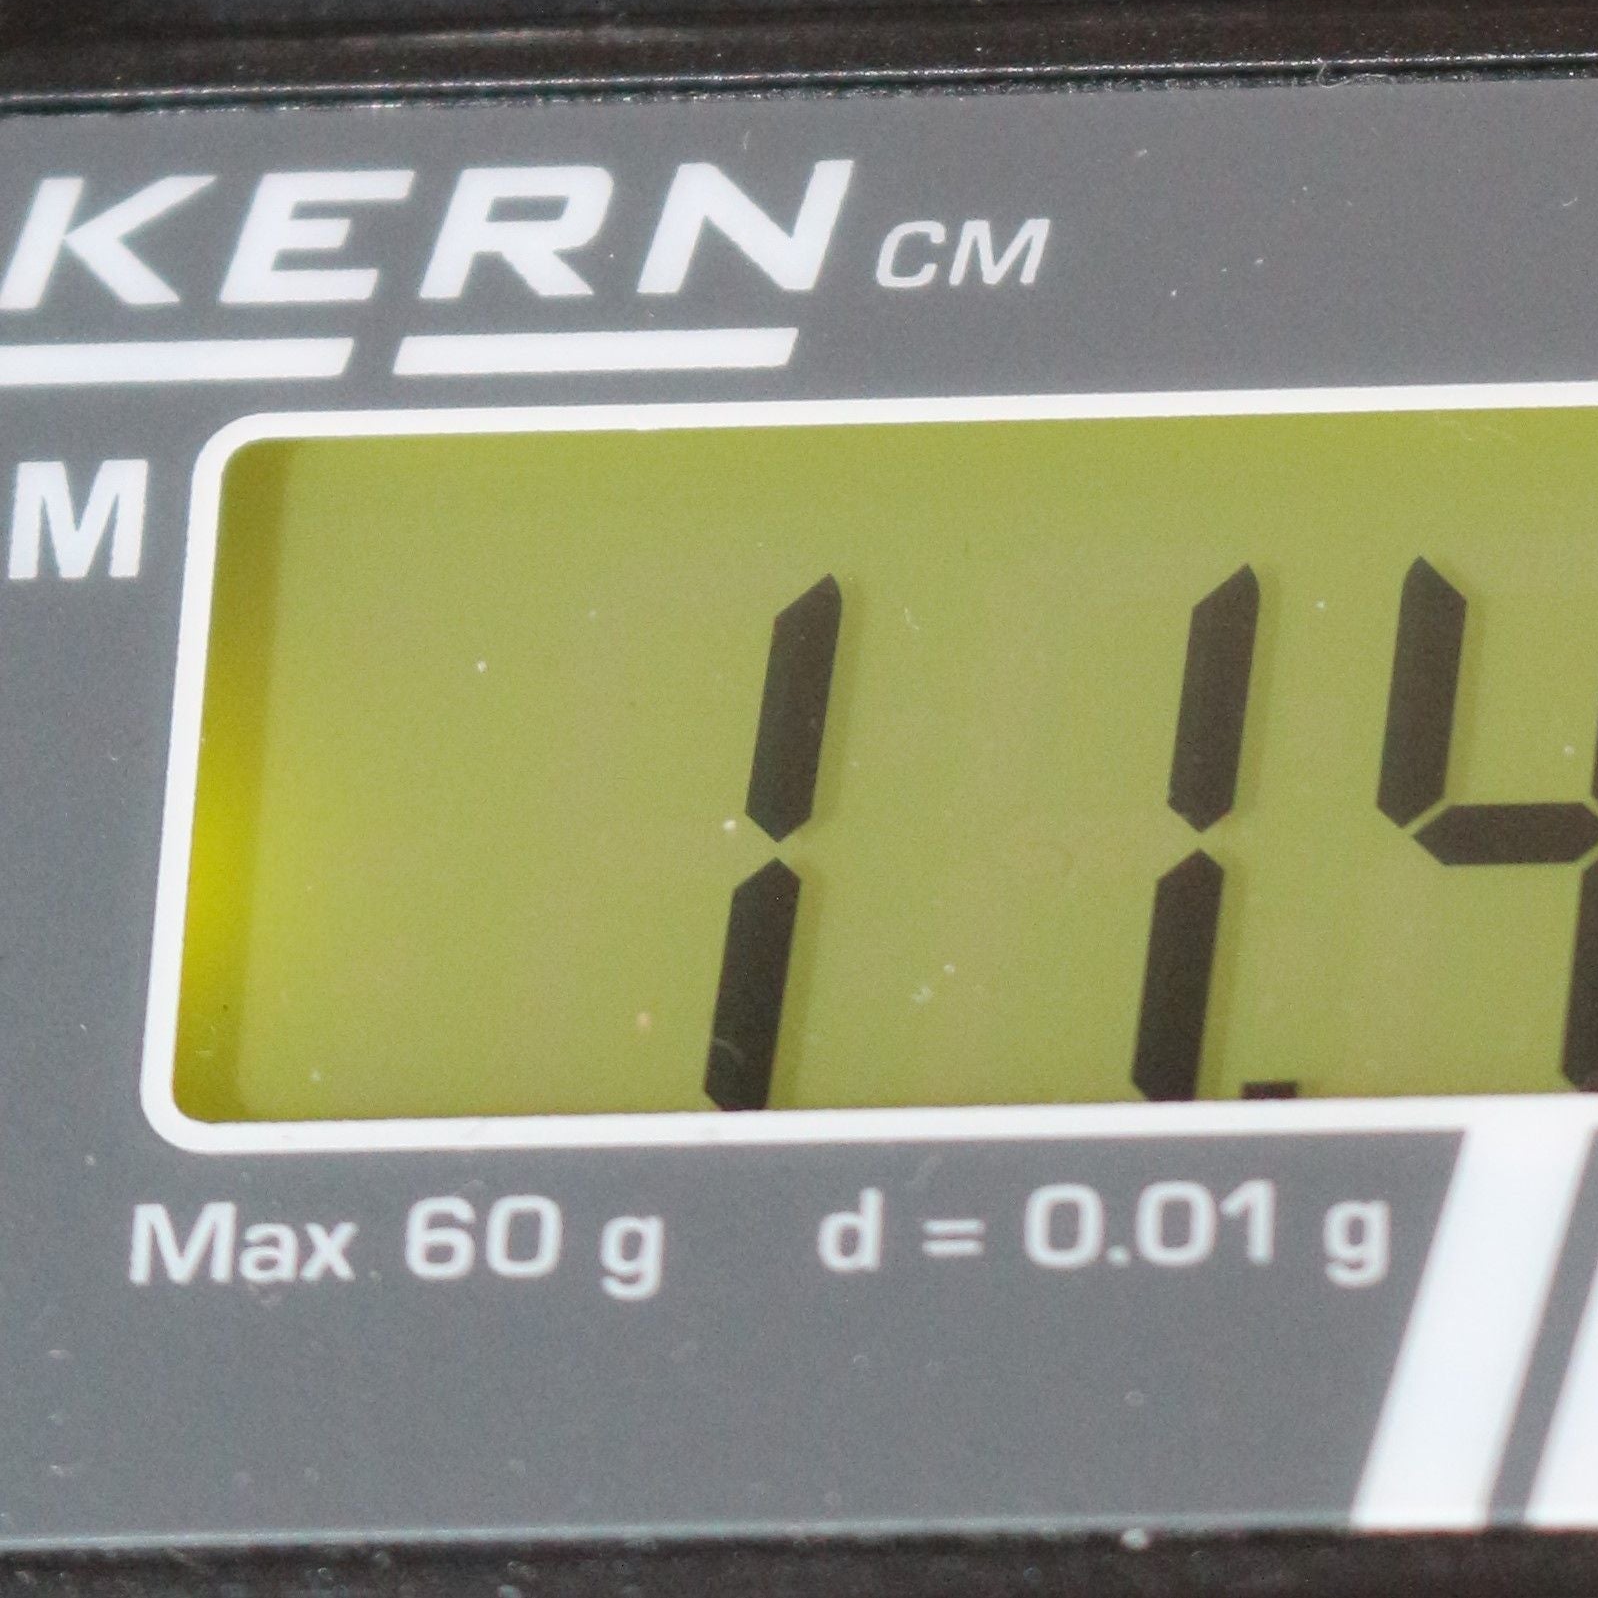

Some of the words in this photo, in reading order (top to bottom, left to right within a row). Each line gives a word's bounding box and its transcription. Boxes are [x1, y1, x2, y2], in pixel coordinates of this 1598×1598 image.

[0, 158, 855, 310] KERN
[874, 217, 1050, 289] CM
[127, 1201, 356, 1287] Max
[403, 1195, 560, 1281] 60
[600, 1209, 665, 1299] g
[815, 1189, 883, 1273] d
[1023, 1179, 1278, 1271] 0.01
[1323, 1195, 1392, 1287] g
